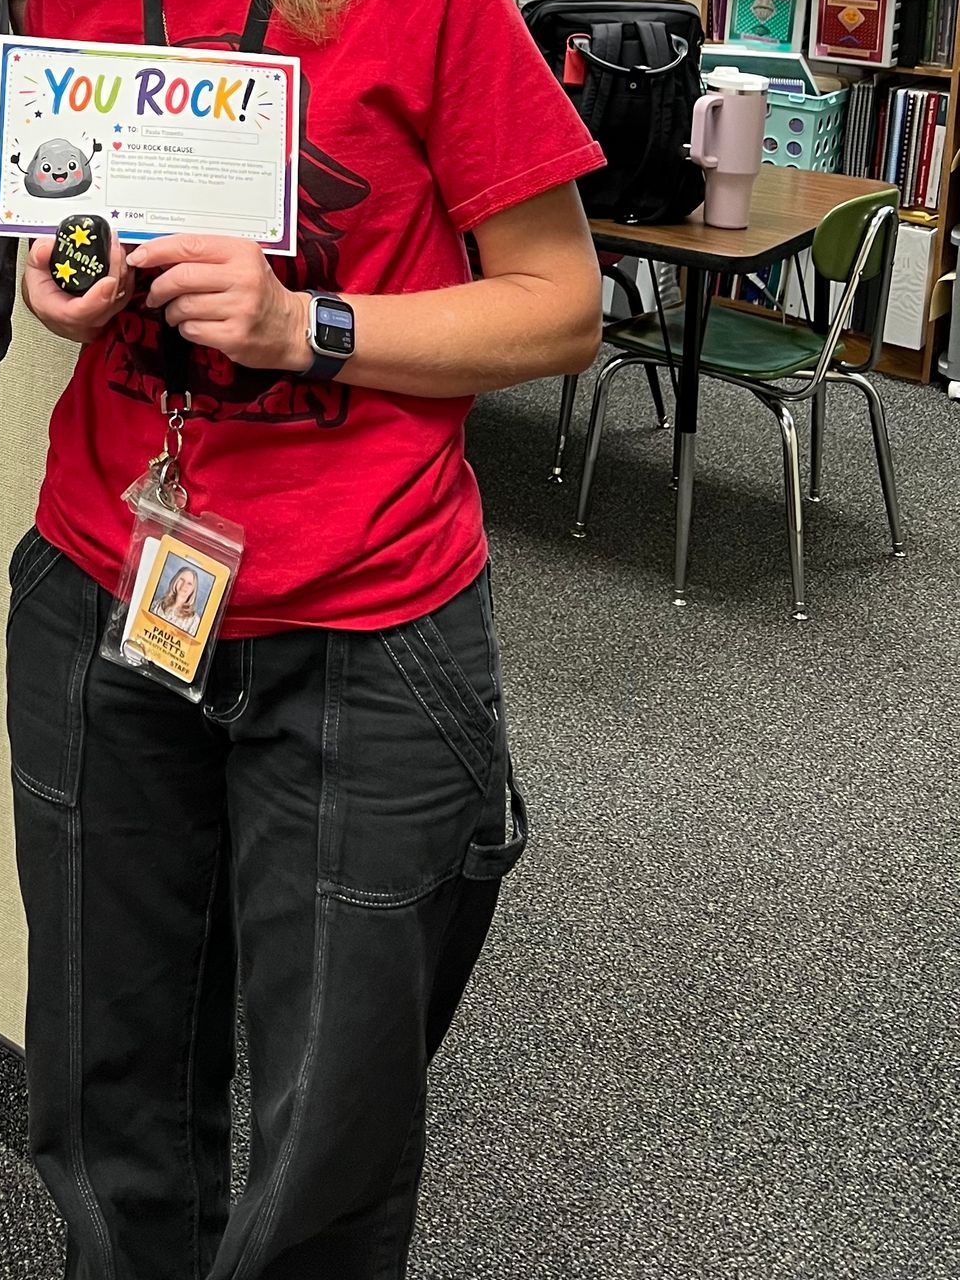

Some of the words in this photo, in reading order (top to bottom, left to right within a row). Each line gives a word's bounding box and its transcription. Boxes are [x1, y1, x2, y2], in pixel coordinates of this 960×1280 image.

[44, 66, 122, 115] YOU
[135, 67, 256, 122] ROCK!
[143, 144, 162, 152] ROCK
[58, 237, 104, 274] Thanks
[143, 628, 186, 659] TIPPETTS
[152, 626, 182, 648] PAULA
[170, 660, 190, 674] STAFF
